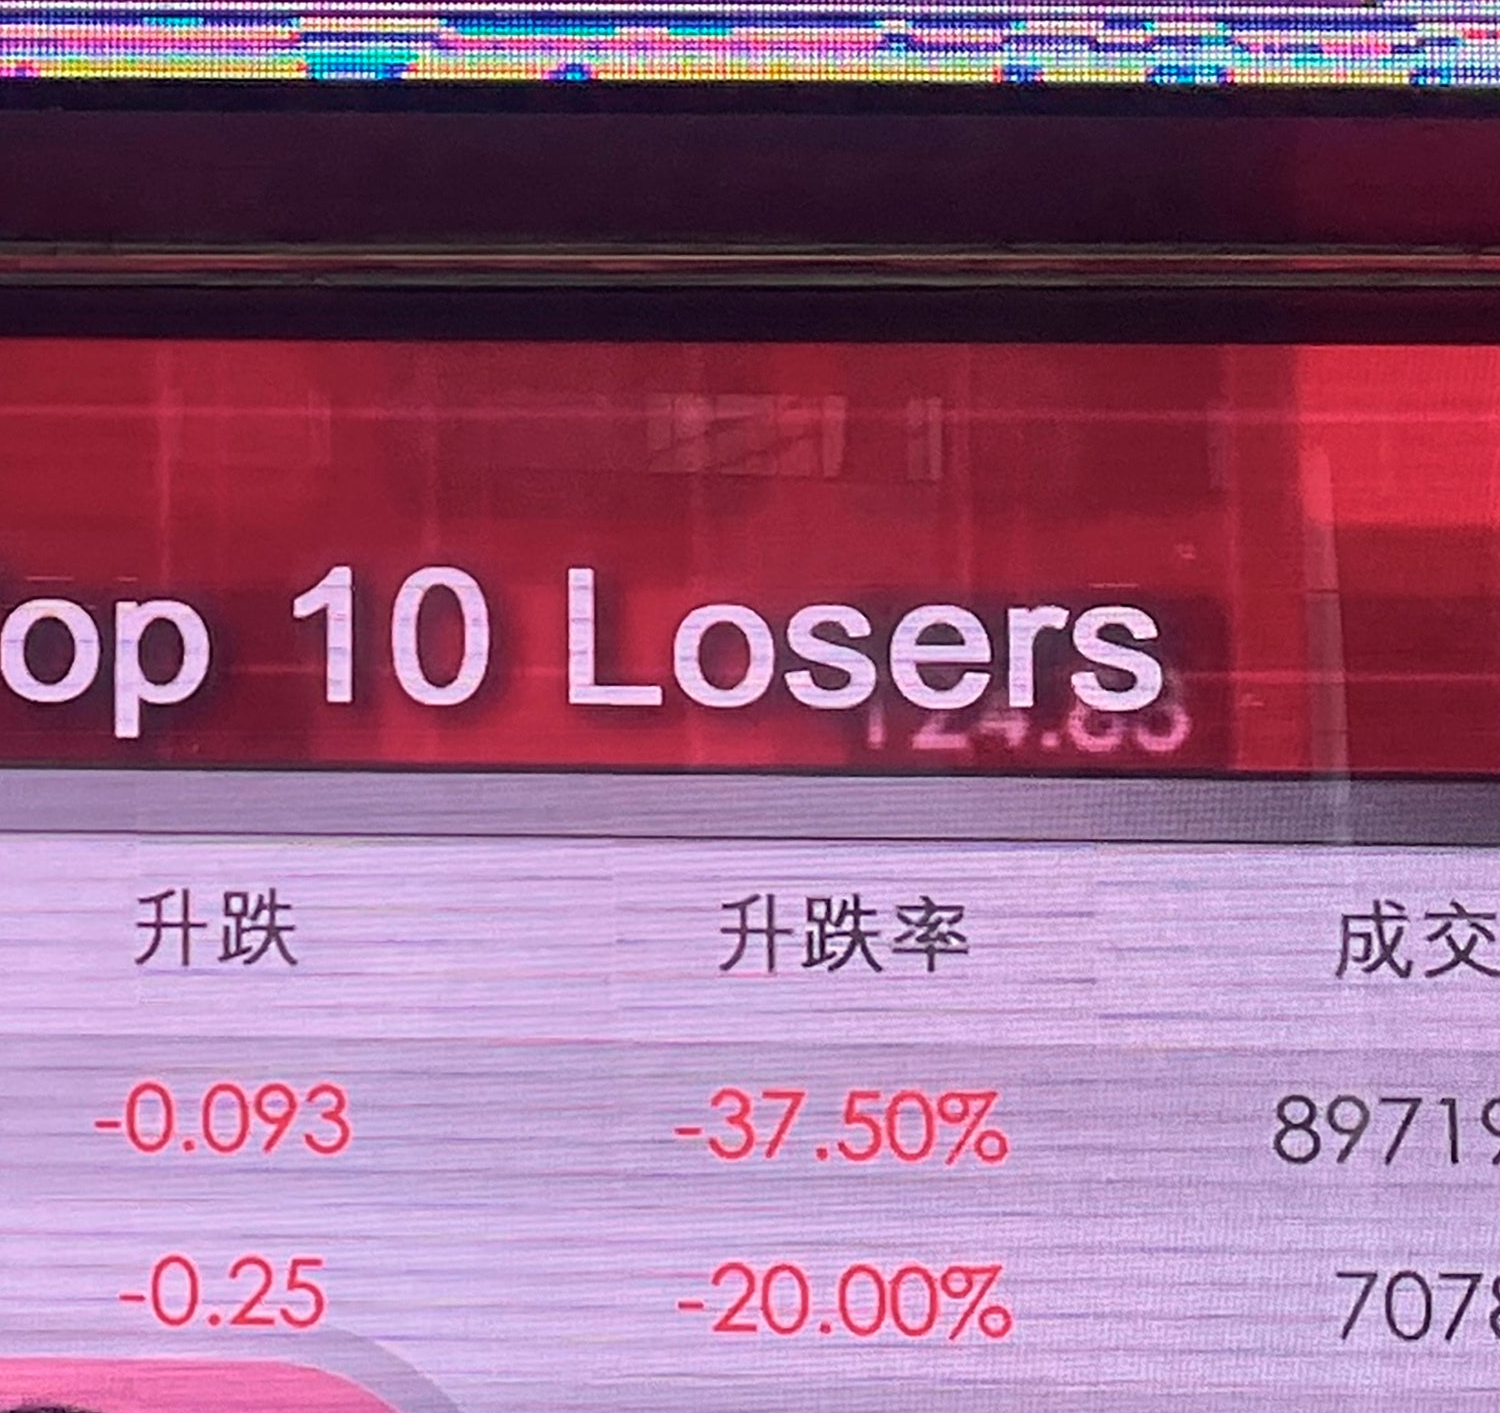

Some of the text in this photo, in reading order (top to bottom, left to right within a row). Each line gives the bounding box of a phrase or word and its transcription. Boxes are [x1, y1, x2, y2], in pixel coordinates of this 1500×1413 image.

[290, 564, 491, 705] 10
[566, 566, 1163, 715] Losers
[135, 888, 298, 967] 升跌
[720, 893, 969, 973] 升跌率
[97, 1080, 352, 1156] -0.093
[678, 1088, 1009, 1164] -37.50%
[122, 1254, 326, 1330] -0.25
[682, 1262, 1013, 1339] -20.00%
